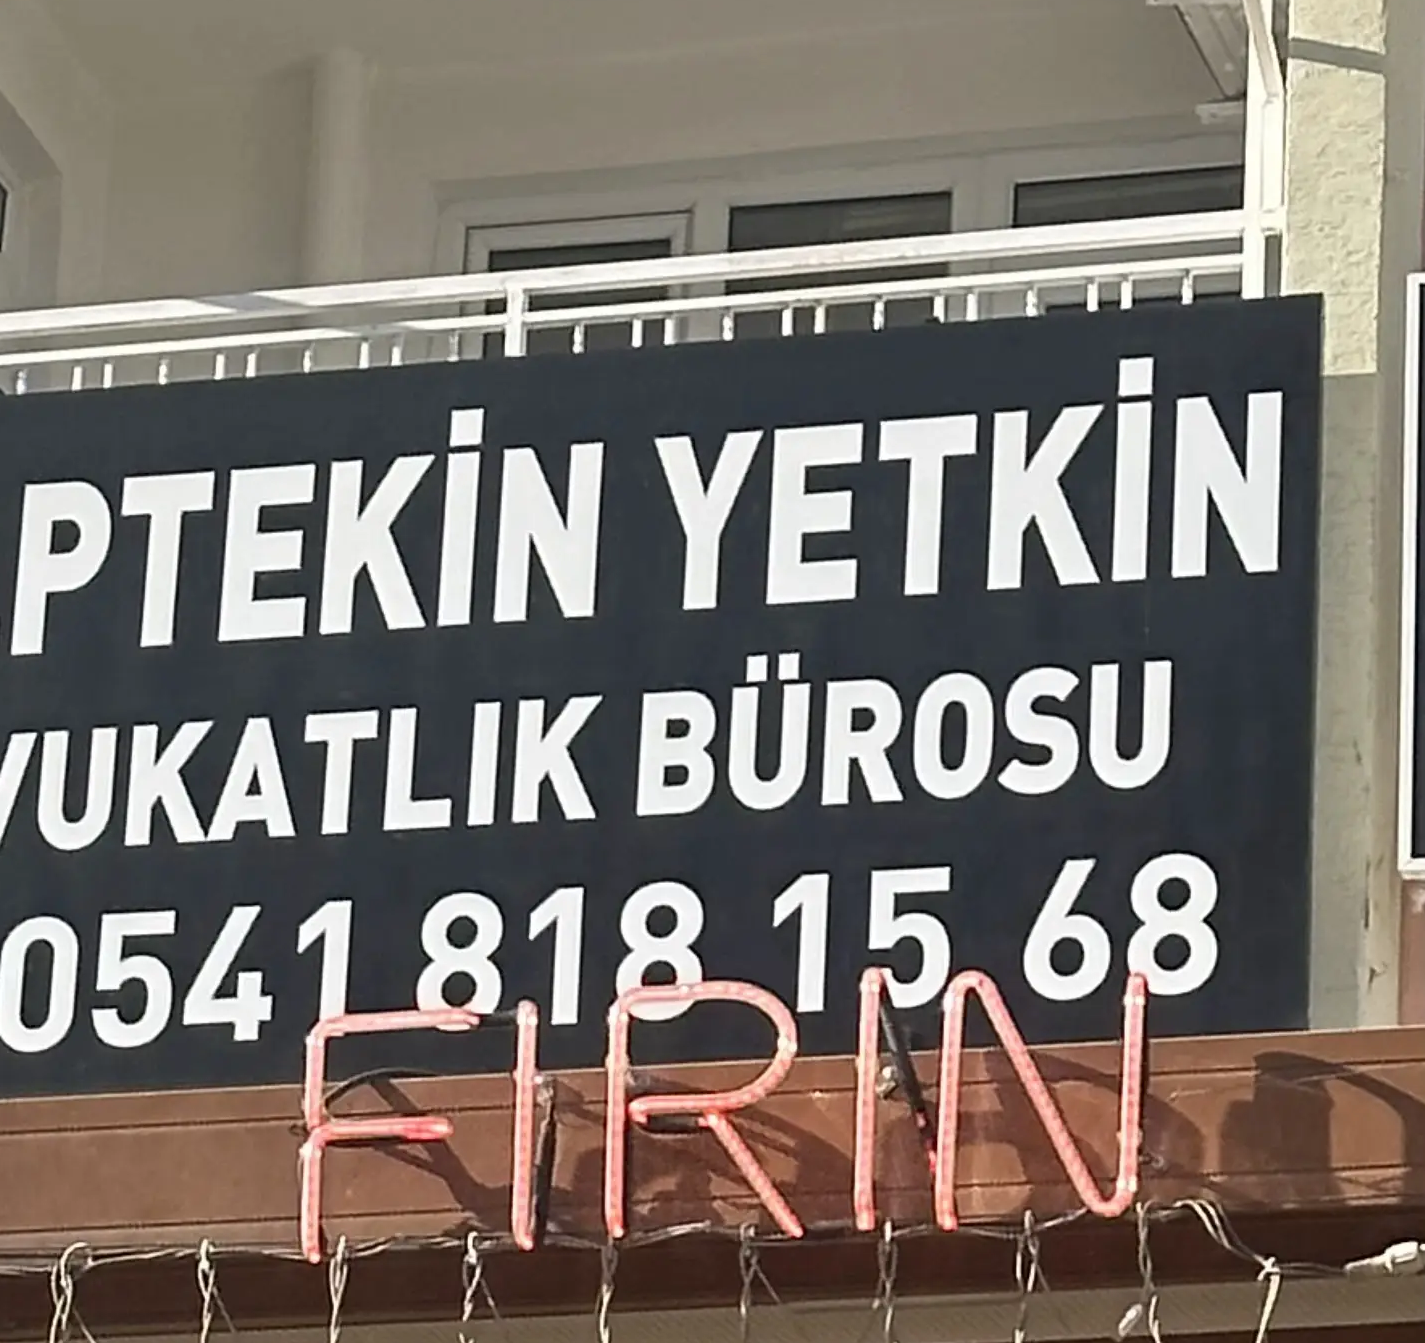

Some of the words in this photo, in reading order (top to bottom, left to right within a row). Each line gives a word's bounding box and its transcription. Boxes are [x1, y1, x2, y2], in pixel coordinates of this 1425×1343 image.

[655, 358, 1282, 610] YETKİN
[637, 653, 1171, 816] BÜROSU
[416, 880, 705, 1032] 818
[772, 865, 953, 1014] 15
[1021, 852, 1219, 1001] 68
[300, 967, 1148, 1262] FIRIN
